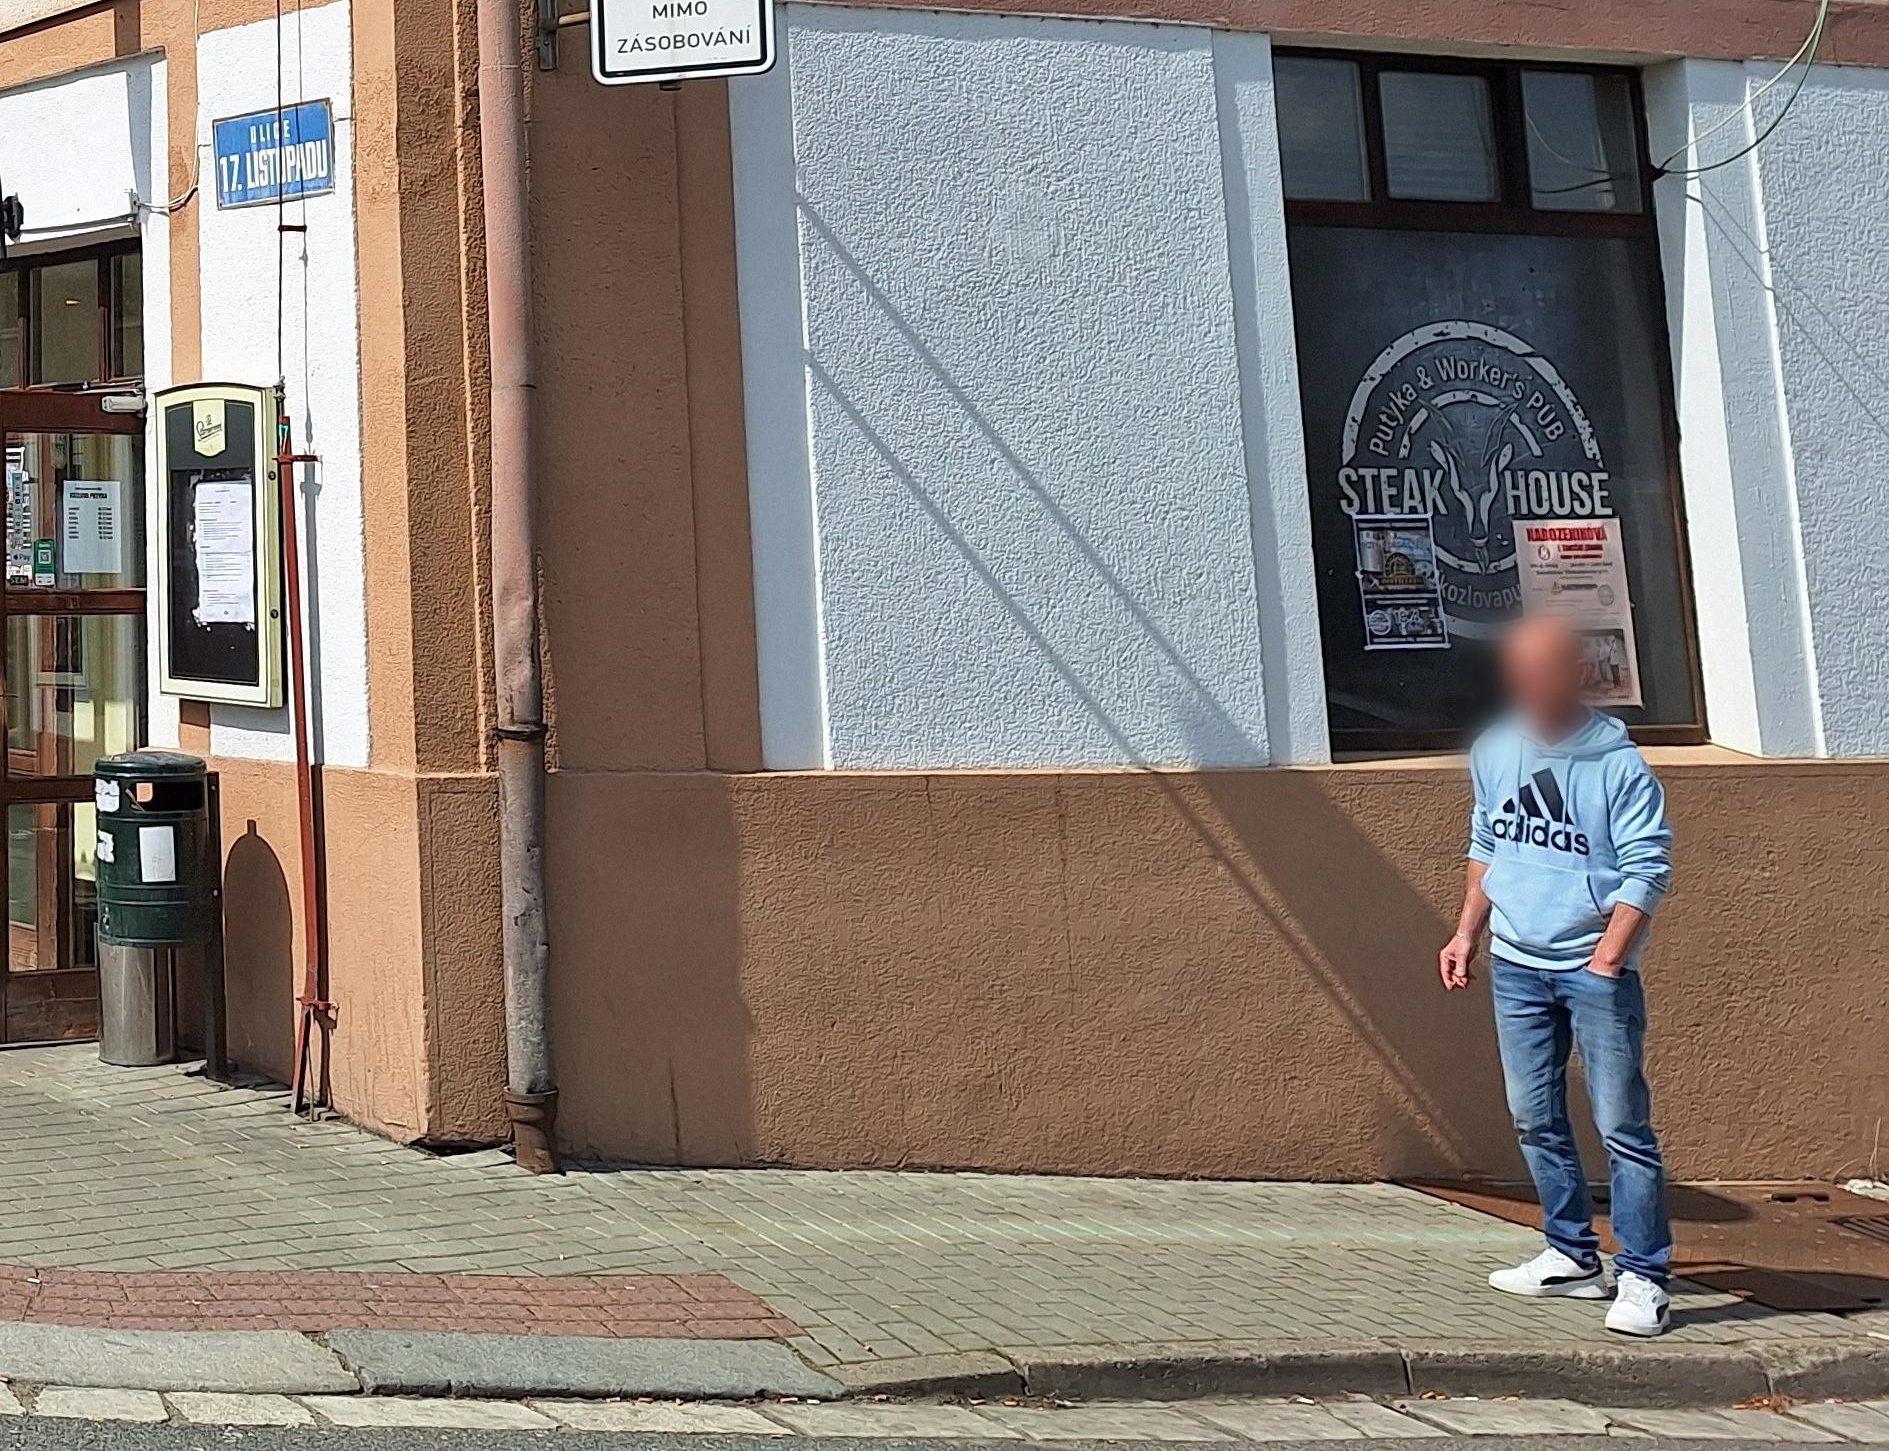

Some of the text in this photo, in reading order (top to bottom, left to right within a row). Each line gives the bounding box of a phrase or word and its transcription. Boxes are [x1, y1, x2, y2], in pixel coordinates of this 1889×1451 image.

[652, 1, 708, 20] MIMO
[617, 25, 752, 54] ZÁSOBOVÁNÍ
[249, 120, 290, 143] ULICE
[219, 139, 328, 193] 17. LISTOPADU
[1416, 365, 1434, 390] &
[1435, 355, 1527, 399] Worker's
[1526, 391, 1565, 441] PUB
[1338, 467, 1613, 516] STEAK HOUSE
[1492, 815, 1590, 856] adidas
